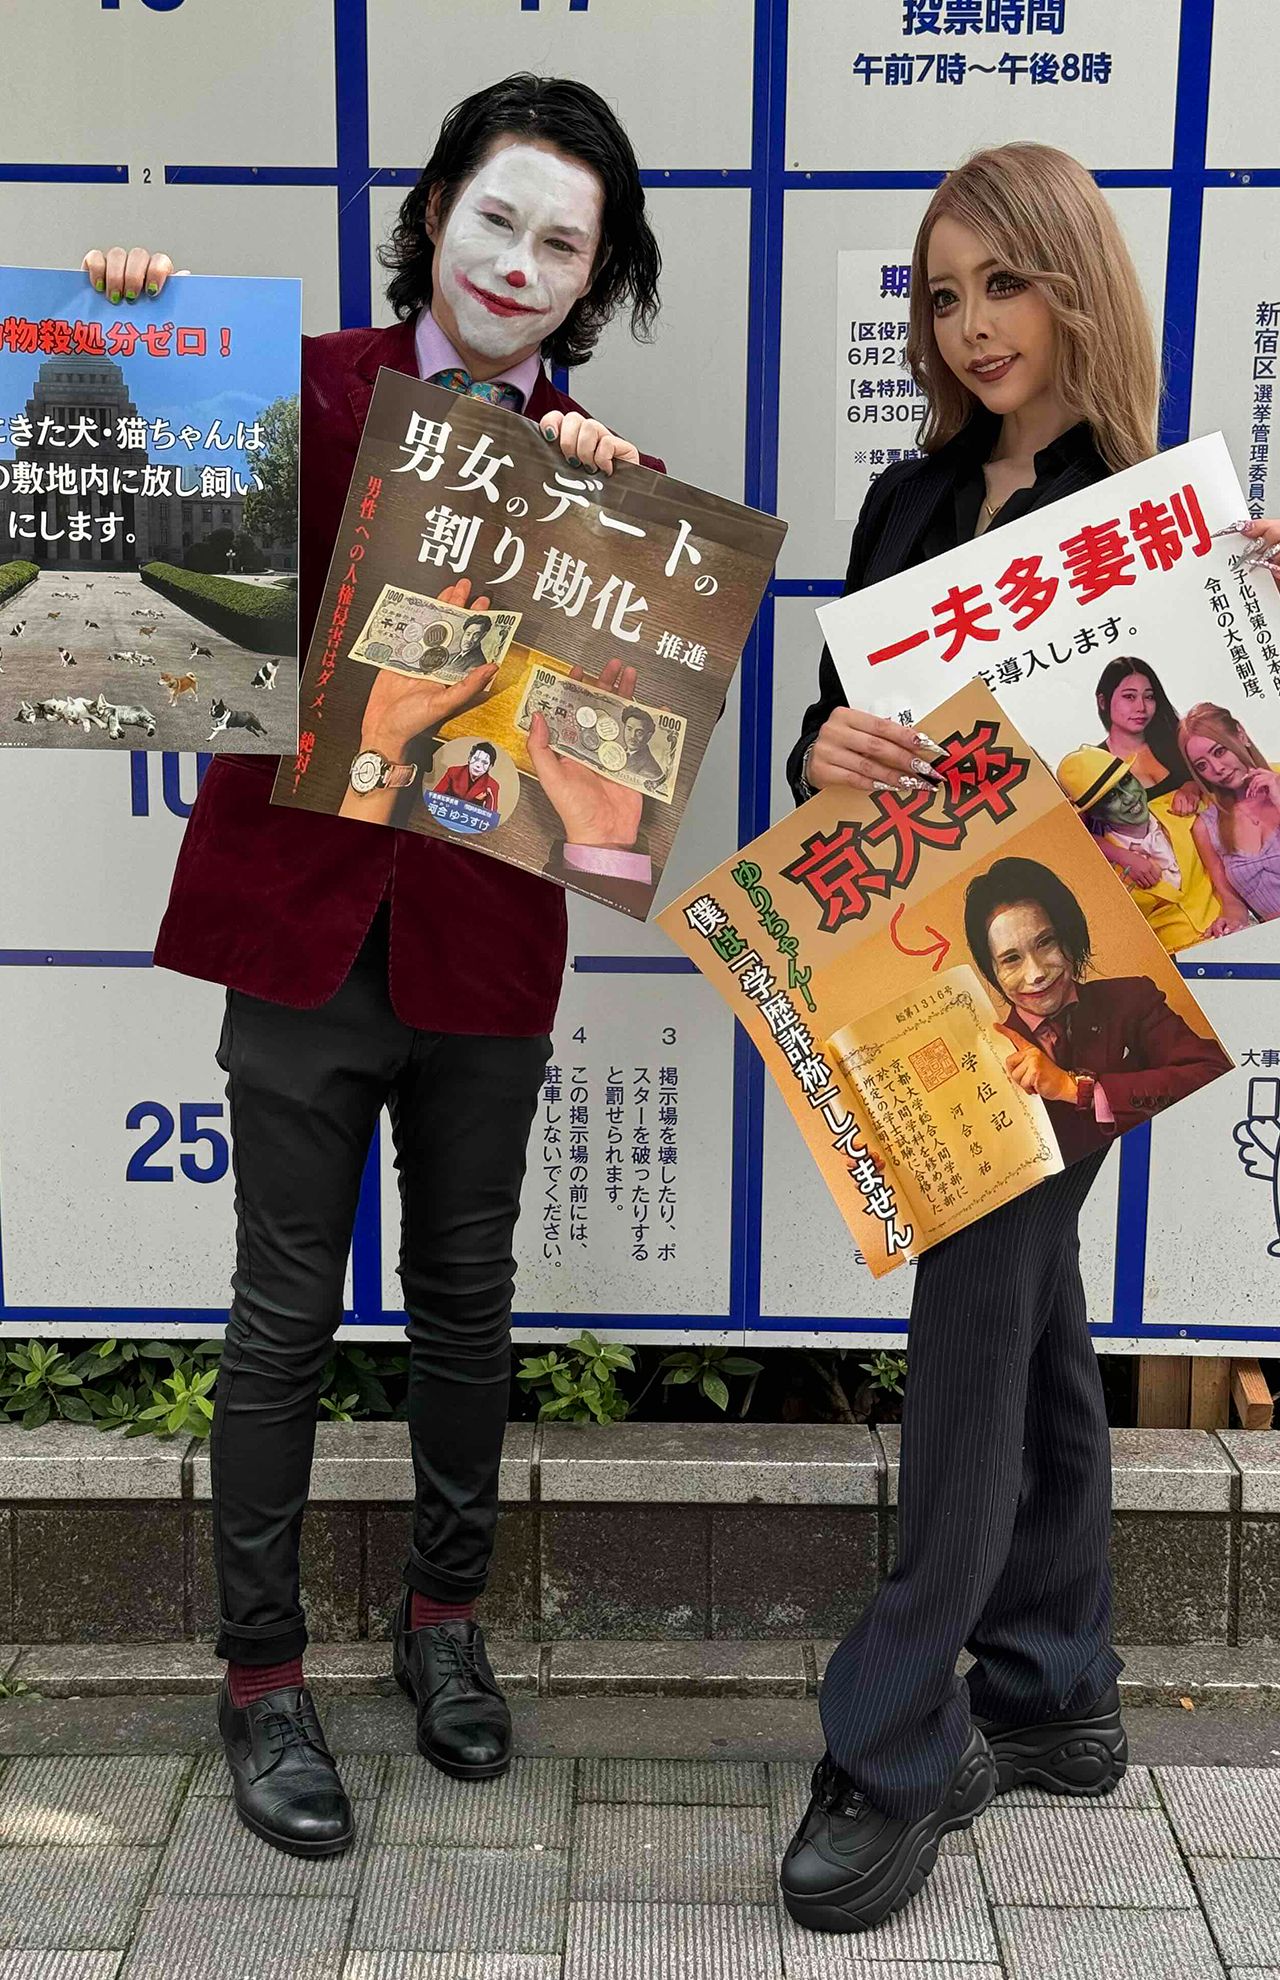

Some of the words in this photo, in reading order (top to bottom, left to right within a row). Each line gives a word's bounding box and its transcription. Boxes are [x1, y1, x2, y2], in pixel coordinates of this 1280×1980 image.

[902, 0, 1065, 36] 投票時間
[853, 52, 1112, 86] 午前7時～午後8時
[142, 168, 152, 185] 2
[0, 316, 232, 357] 物殺処分ゼロ！
[850, 379, 926, 399] 【各特別
[0, 415, 266, 450] きた犬・猫ちゃんは
[854, 448, 929, 465] ※投票時
[8, 510, 137, 544] にします。
[390, 410, 719, 597] 男女のデートの
[867, 484, 1213, 667] 一夫多妻制
[535, 669, 557, 686] 1000
[1204, 577, 1266, 699] 令和の大奥制度。
[658, 714, 682, 732] 1000
[449, 809, 490, 831] ゆうすけ
[780, 720, 1031, 935] 京大卒
[731, 860, 817, 1012] ゆりちゃん！
[572, 1027, 587, 1044] 4
[662, 1027, 677, 1045] 3
[683, 894, 912, 1257] 僕は「学歴詐称」してません
[889, 1058, 969, 1199] 京都大学総合人間学部に
[961, 1052, 1013, 1132] 学位記
[125, 1101, 229, 1184] 25
[543, 1065, 563, 1268] 駐車しないでください。
[569, 1066, 589, 1249] この掲示場の前には、
[605, 1066, 624, 1212] と罰せられます。
[631, 1067, 651, 1262] スターを破ったりする
[658, 1066, 679, 1262] 掲示場を壊したり、ポ
